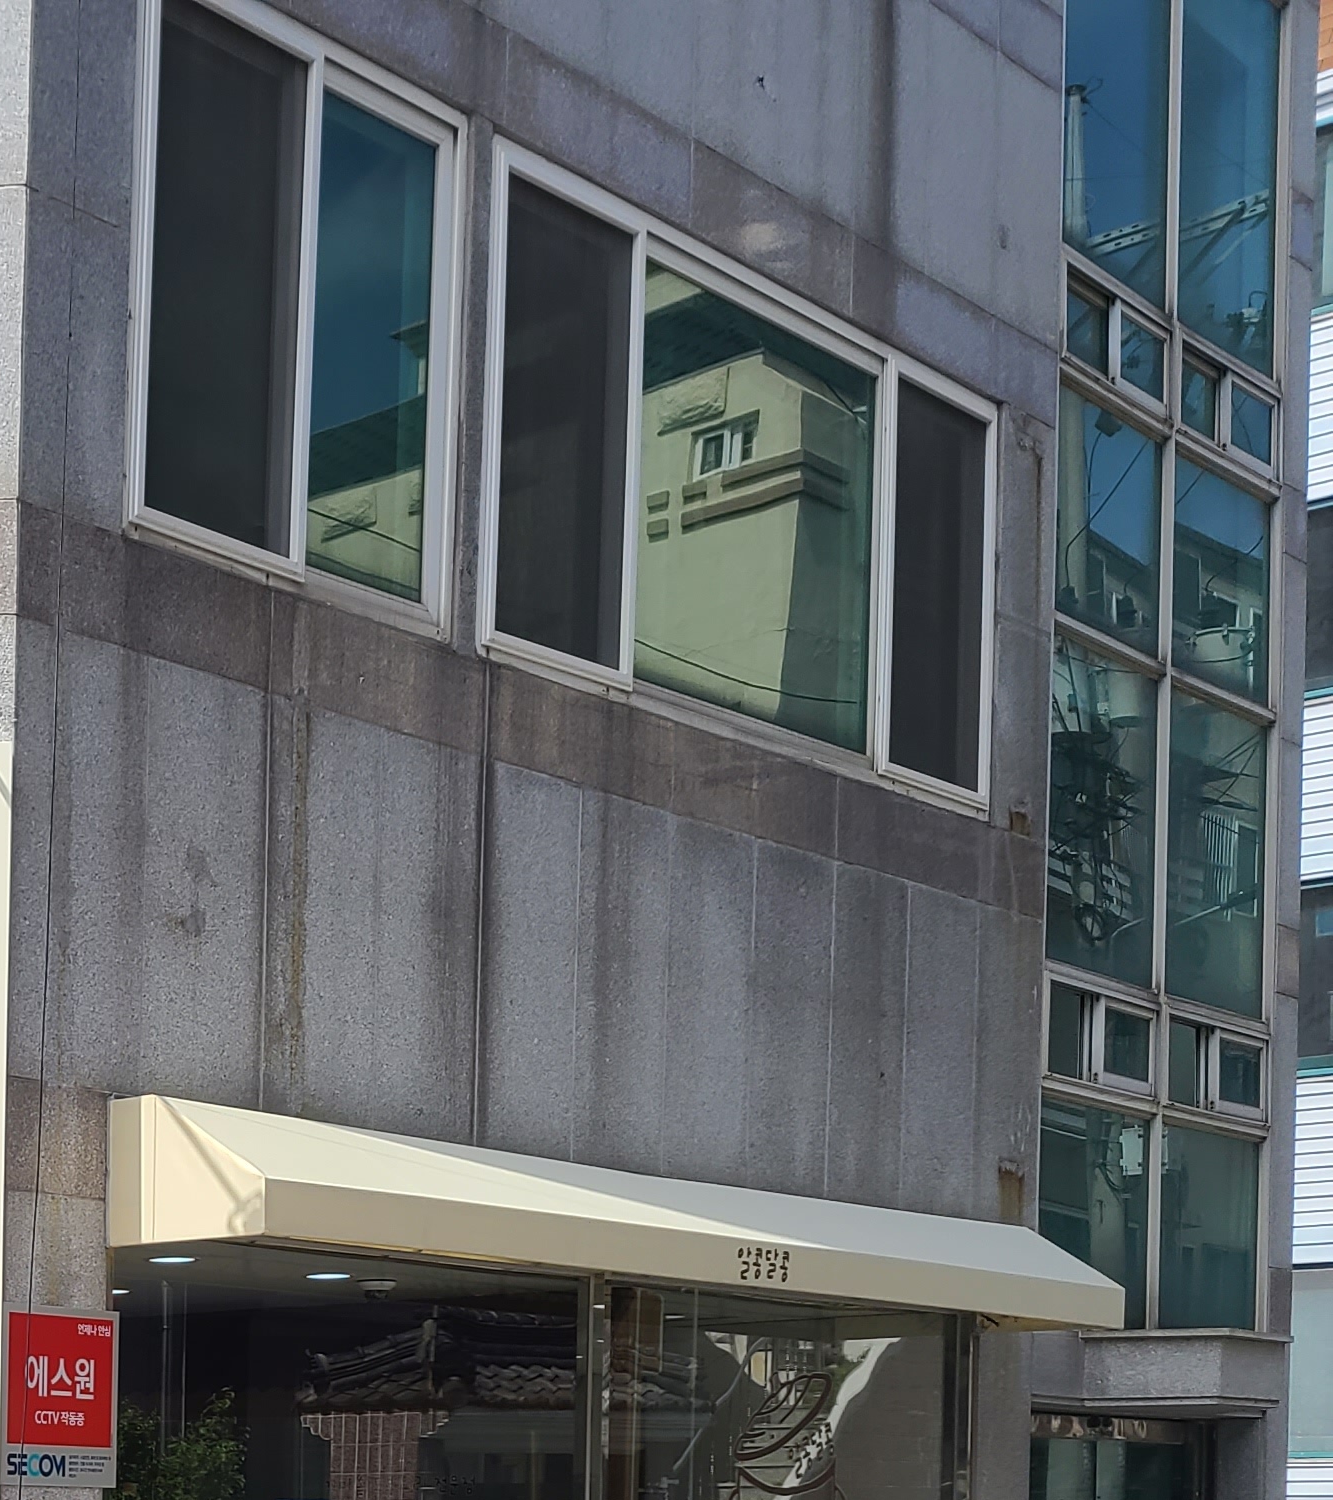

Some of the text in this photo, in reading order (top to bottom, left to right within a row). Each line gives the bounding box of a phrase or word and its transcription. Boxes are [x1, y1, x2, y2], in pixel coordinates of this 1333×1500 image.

[737, 1247, 791, 1283] 알콩달콩
[97, 1325, 112, 1338] 안심
[24, 1355, 95, 1400] 에스원
[35, 1410, 60, 1425] CCTV
[7, 1453, 66, 1478] SECOM
